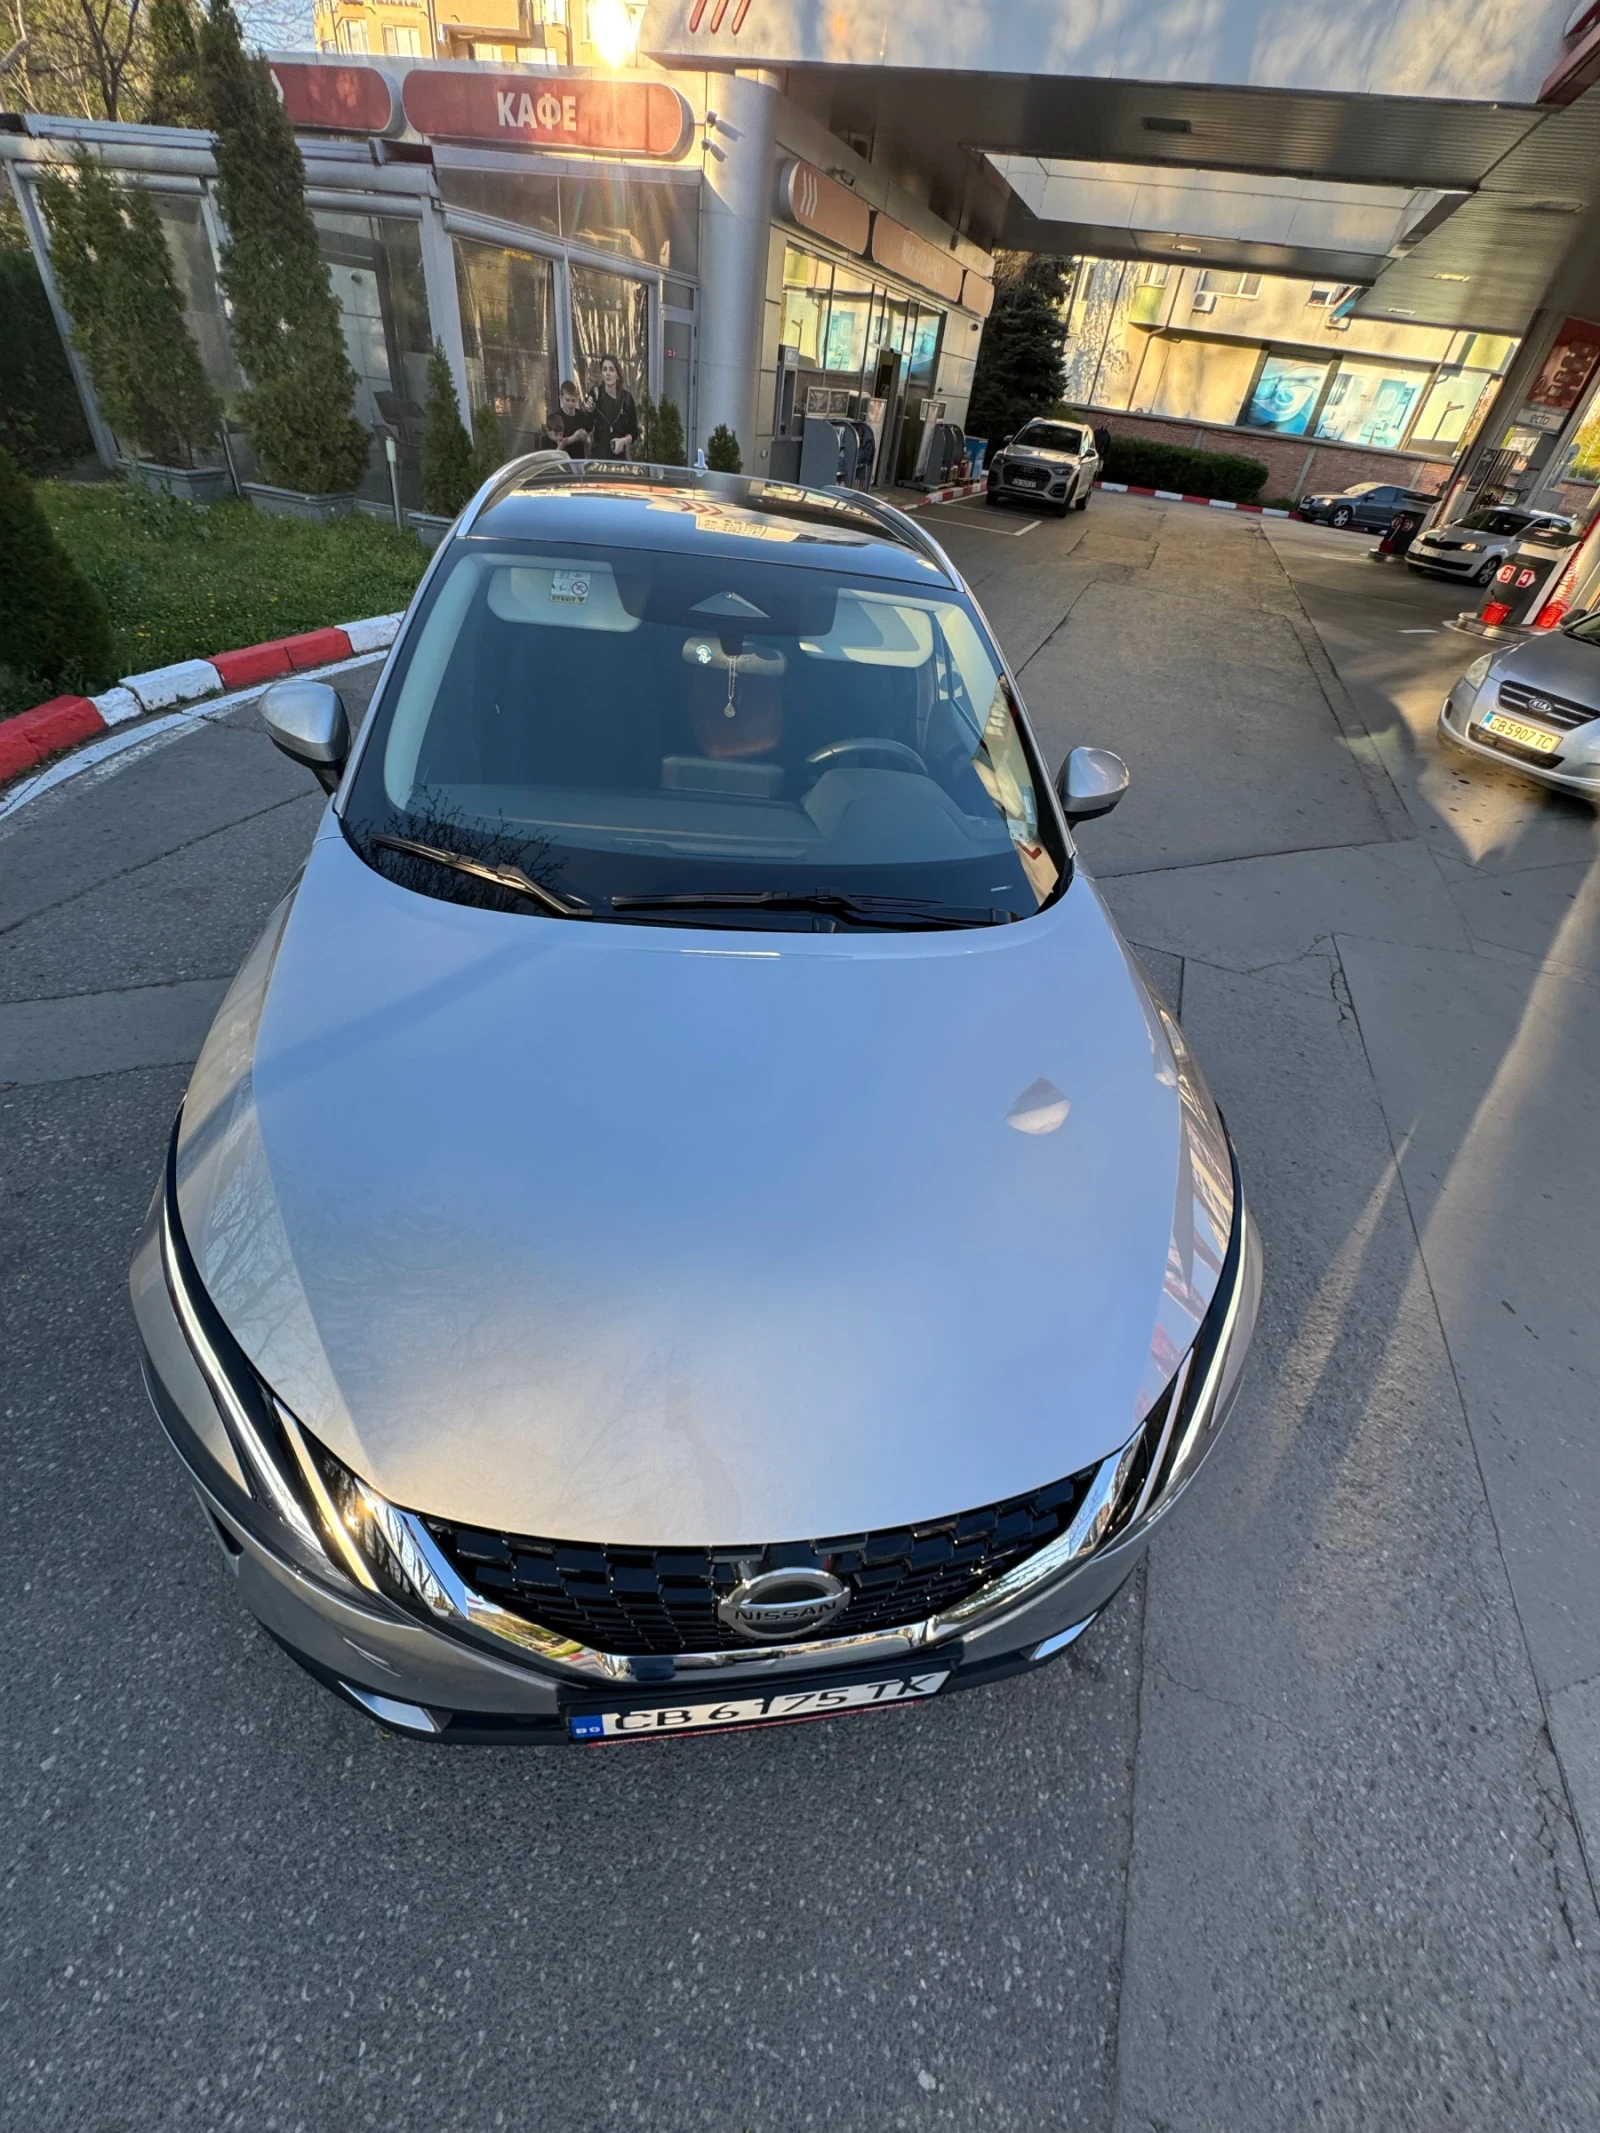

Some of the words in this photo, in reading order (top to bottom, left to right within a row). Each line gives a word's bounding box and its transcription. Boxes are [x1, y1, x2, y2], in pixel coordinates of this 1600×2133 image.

[497, 91, 577, 131] КАФЕ
[1530, 413, 1550, 426] ecto
[1503, 568, 1512, 580] 3
[1520, 572, 1530, 586] 4
[1532, 700, 1549, 710] KIA
[1489, 718, 1506, 732] CB
[1505, 723, 1536, 742] 5907
[1535, 734, 1553, 750] TC
[734, 1601, 837, 1621] NISSAN
[615, 1710, 693, 1730] CB
[708, 1688, 850, 1720] 6175
[867, 1675, 937, 1700] TK
